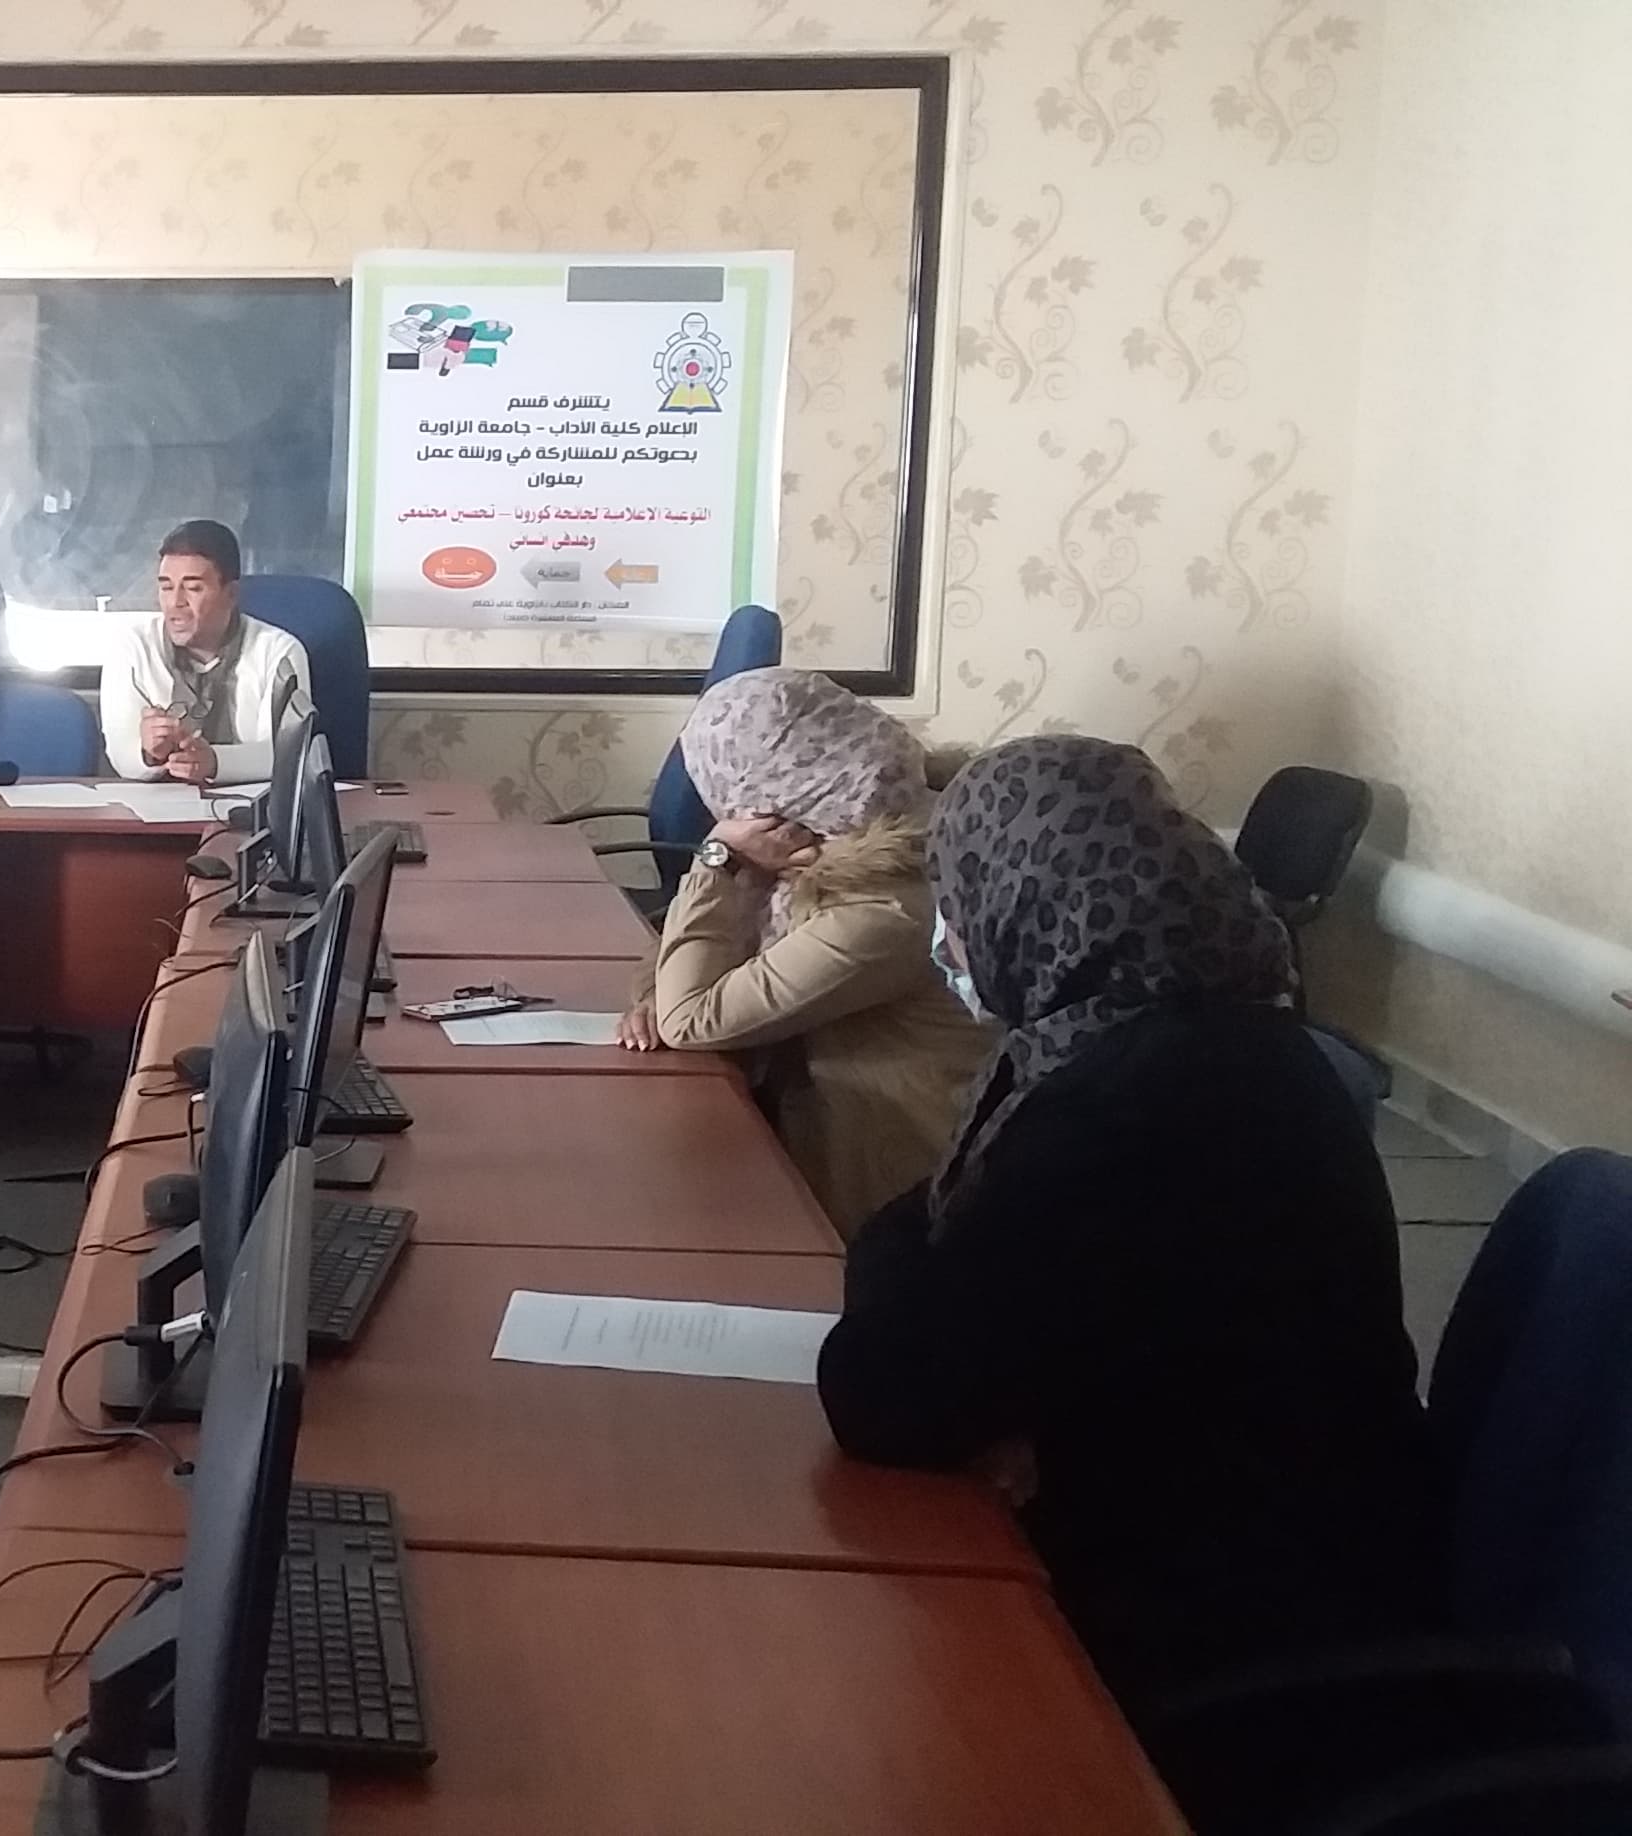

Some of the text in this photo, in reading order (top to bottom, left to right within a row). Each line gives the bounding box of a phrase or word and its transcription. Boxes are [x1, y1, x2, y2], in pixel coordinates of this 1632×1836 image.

[506, 395, 611, 412] يتشرف قسم
[418, 419, 473, 437] الزاوية
[477, 420, 531, 437] جامعة
[600, 420, 641, 438] كلية
[416, 445, 454, 462] عمل
[458, 445, 503, 462] ورشة
[506, 446, 532, 467] في
[535, 446, 618, 463] للمشاركة
[527, 471, 583, 489] بعنوان
[514, 504, 551, 524] كورونا
